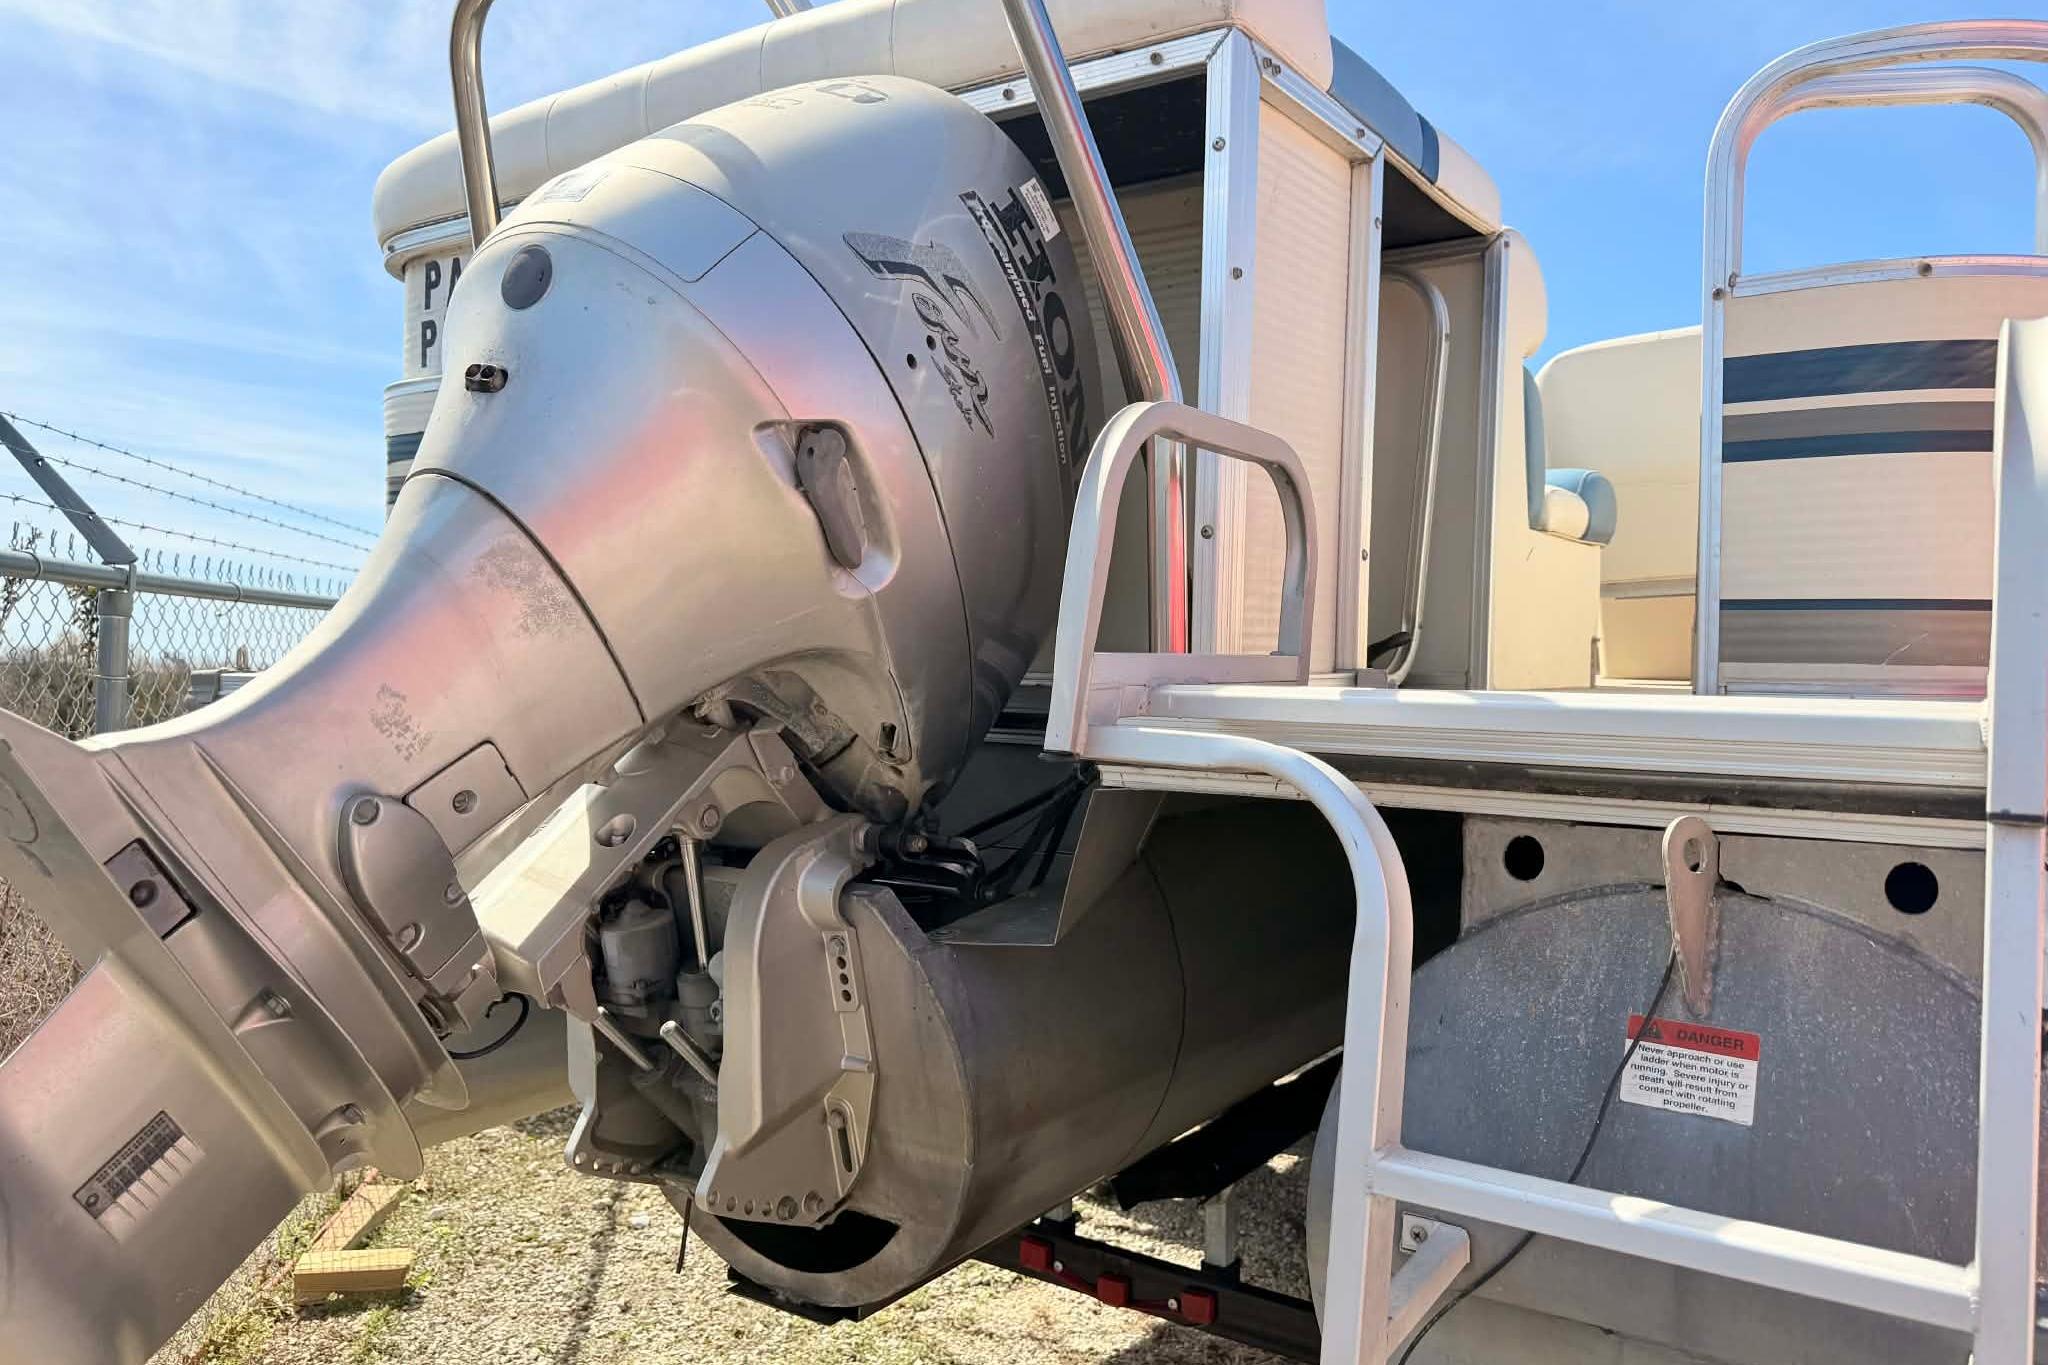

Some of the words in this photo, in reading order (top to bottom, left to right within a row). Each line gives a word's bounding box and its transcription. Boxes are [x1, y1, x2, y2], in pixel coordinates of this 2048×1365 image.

[988, 187, 1089, 480] HON
[1034, 333, 1052, 374] Fuel
[1049, 386, 1066, 464] Injection
[1677, 1029, 1744, 1050] DANGER
[1639, 1044, 1665, 1056] Never
[1667, 1049, 1711, 1063] approach
[1726, 1061, 1744, 1069] use
[1641, 1054, 1669, 1065] ladder
[1672, 1060, 1697, 1071] when
[1700, 1066, 1728, 1076] motor
[1731, 1070, 1739, 1079] is
[1630, 1063, 1668, 1076] running.
[1674, 1070, 1705, 1083] Severe
[1709, 1076, 1736, 1090] injury
[1739, 1082, 1750, 1090] or
[1639, 1074, 1665, 1085] death
[1667, 1079, 1684, 1087] will
[1685, 1081, 1712, 1093] result
[1715, 1086, 1738, 1098] from
[1639, 1084, 1673, 1096] contact
[1676, 1090, 1696, 1100] with
[1699, 1094, 1736, 1109] rotating
[1663, 1099, 1709, 1113] propeller.
